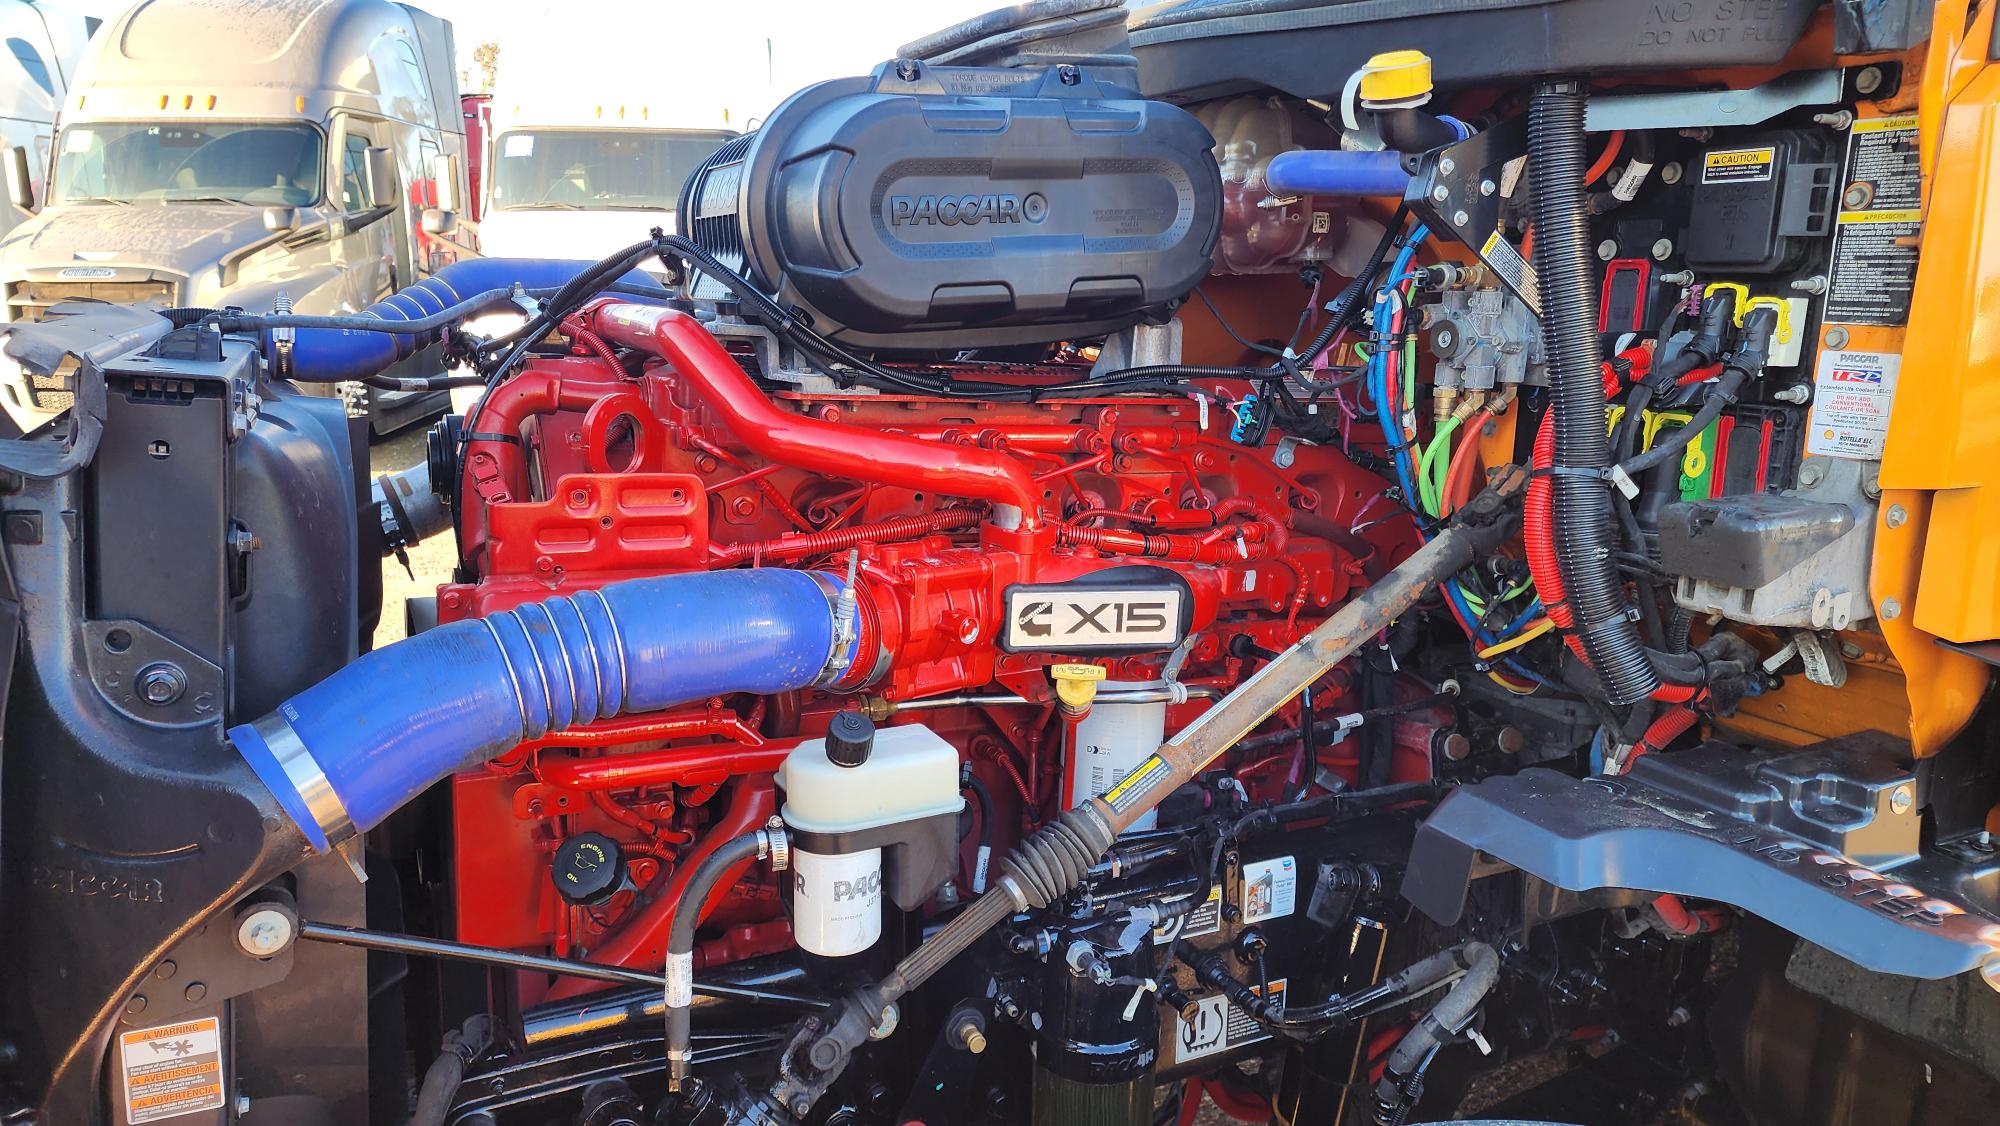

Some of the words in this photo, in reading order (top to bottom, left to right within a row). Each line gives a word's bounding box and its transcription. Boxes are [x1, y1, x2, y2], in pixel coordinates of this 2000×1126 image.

[1646, 2, 1692, 24] NO
[1716, 0, 1788, 20] STEP
[1638, 31, 1671, 45] DO
[1686, 28, 1730, 43] NOT
[1721, 154, 1759, 164] CAUTION
[891, 193, 1020, 227] PACCAR
[1840, 354, 1879, 363] PACCAR
[1832, 369, 1882, 383] TRP
[1832, 400, 1874, 408] CONVENTIONAL
[1018, 601, 1051, 625] Cummins
[1064, 602, 1167, 634] X15
[580, 843, 605, 863] ENGINE
[1735, 836, 1801, 864] NO
[567, 873, 578, 883] OIL
[1820, 873, 1944, 926] STEP
[154, 1024, 199, 1038] WARNING
[143, 1063, 217, 1083] AVERTISSEMENT
[150, 1086, 215, 1105] ADVERTENCIA
